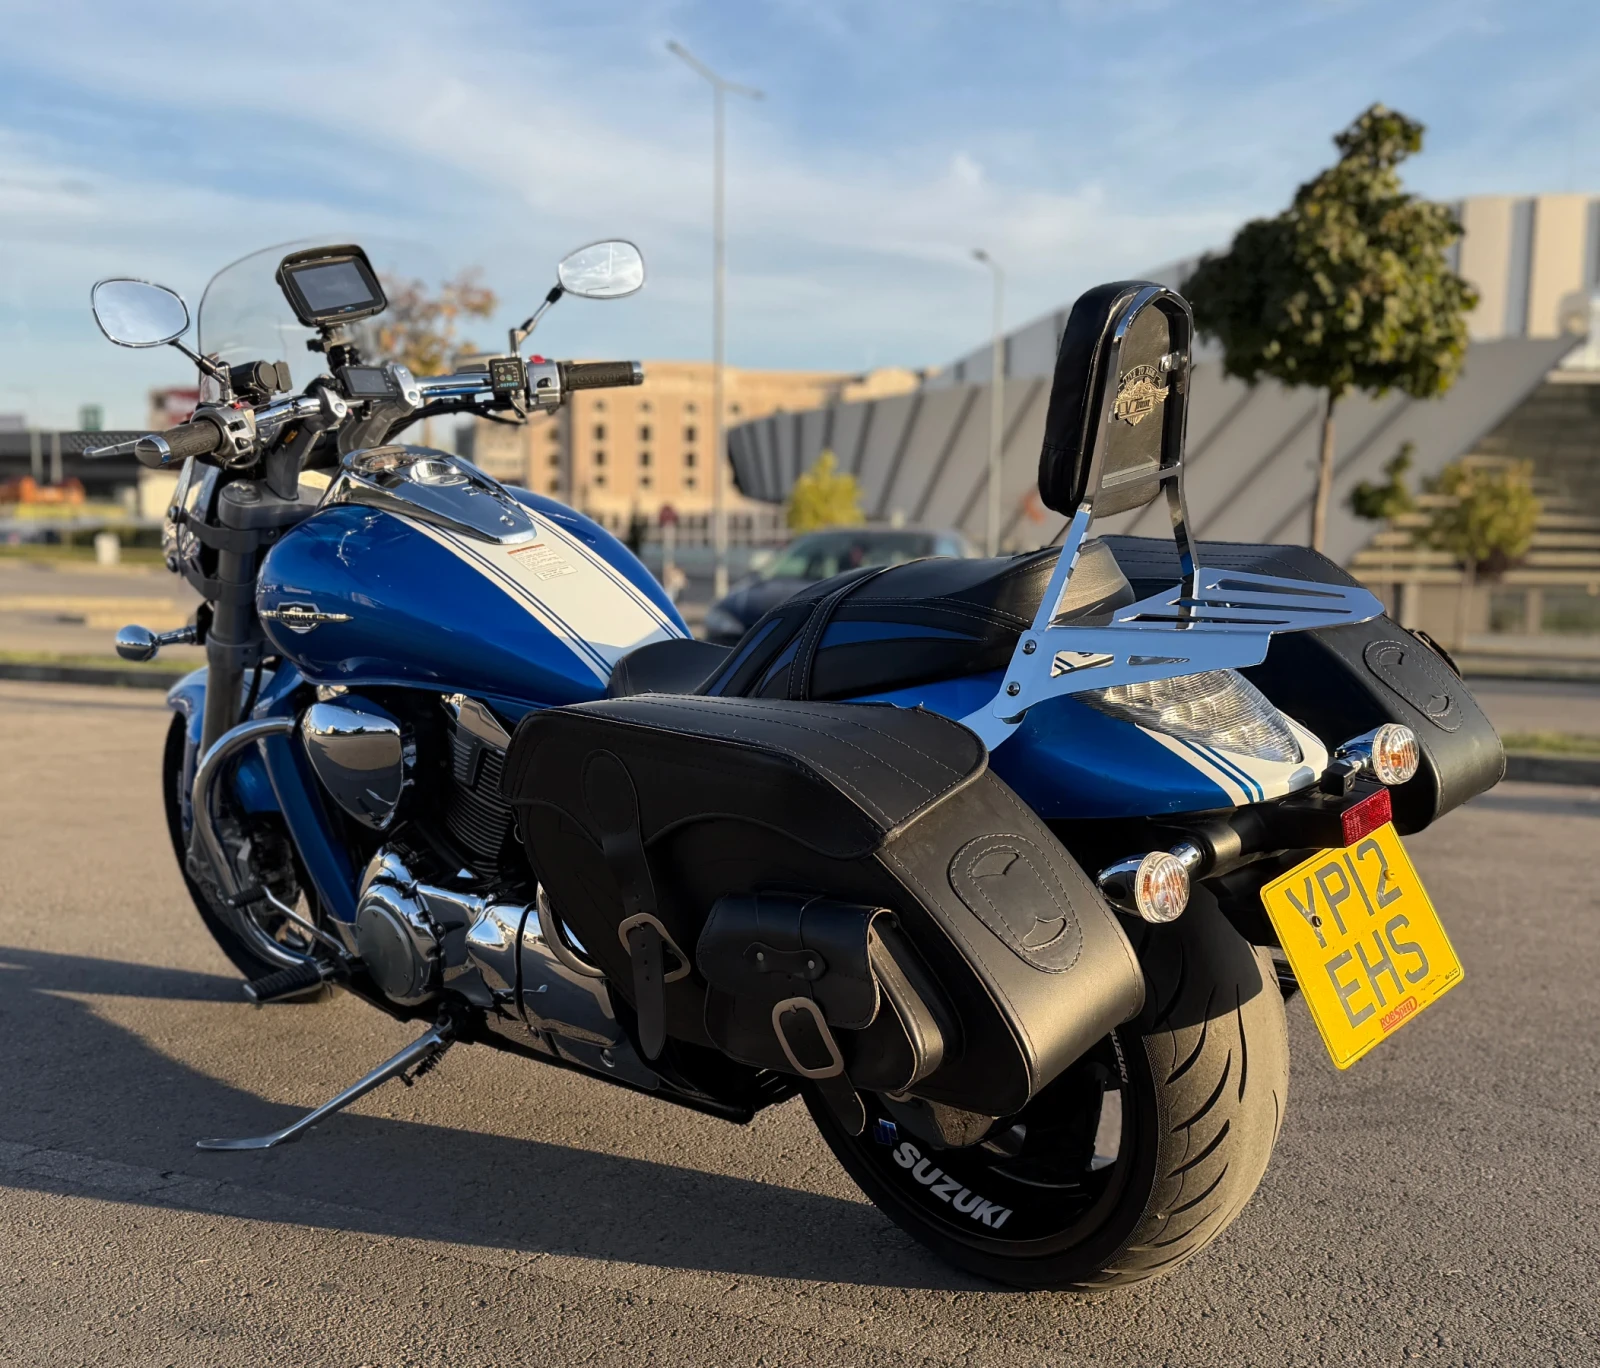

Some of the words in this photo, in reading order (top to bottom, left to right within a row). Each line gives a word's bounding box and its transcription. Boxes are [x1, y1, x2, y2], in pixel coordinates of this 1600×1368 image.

[1285, 838, 1403, 949] YP12
[1324, 913, 1429, 1029] EHS
[892, 1142, 1013, 1229] SUZUKI
